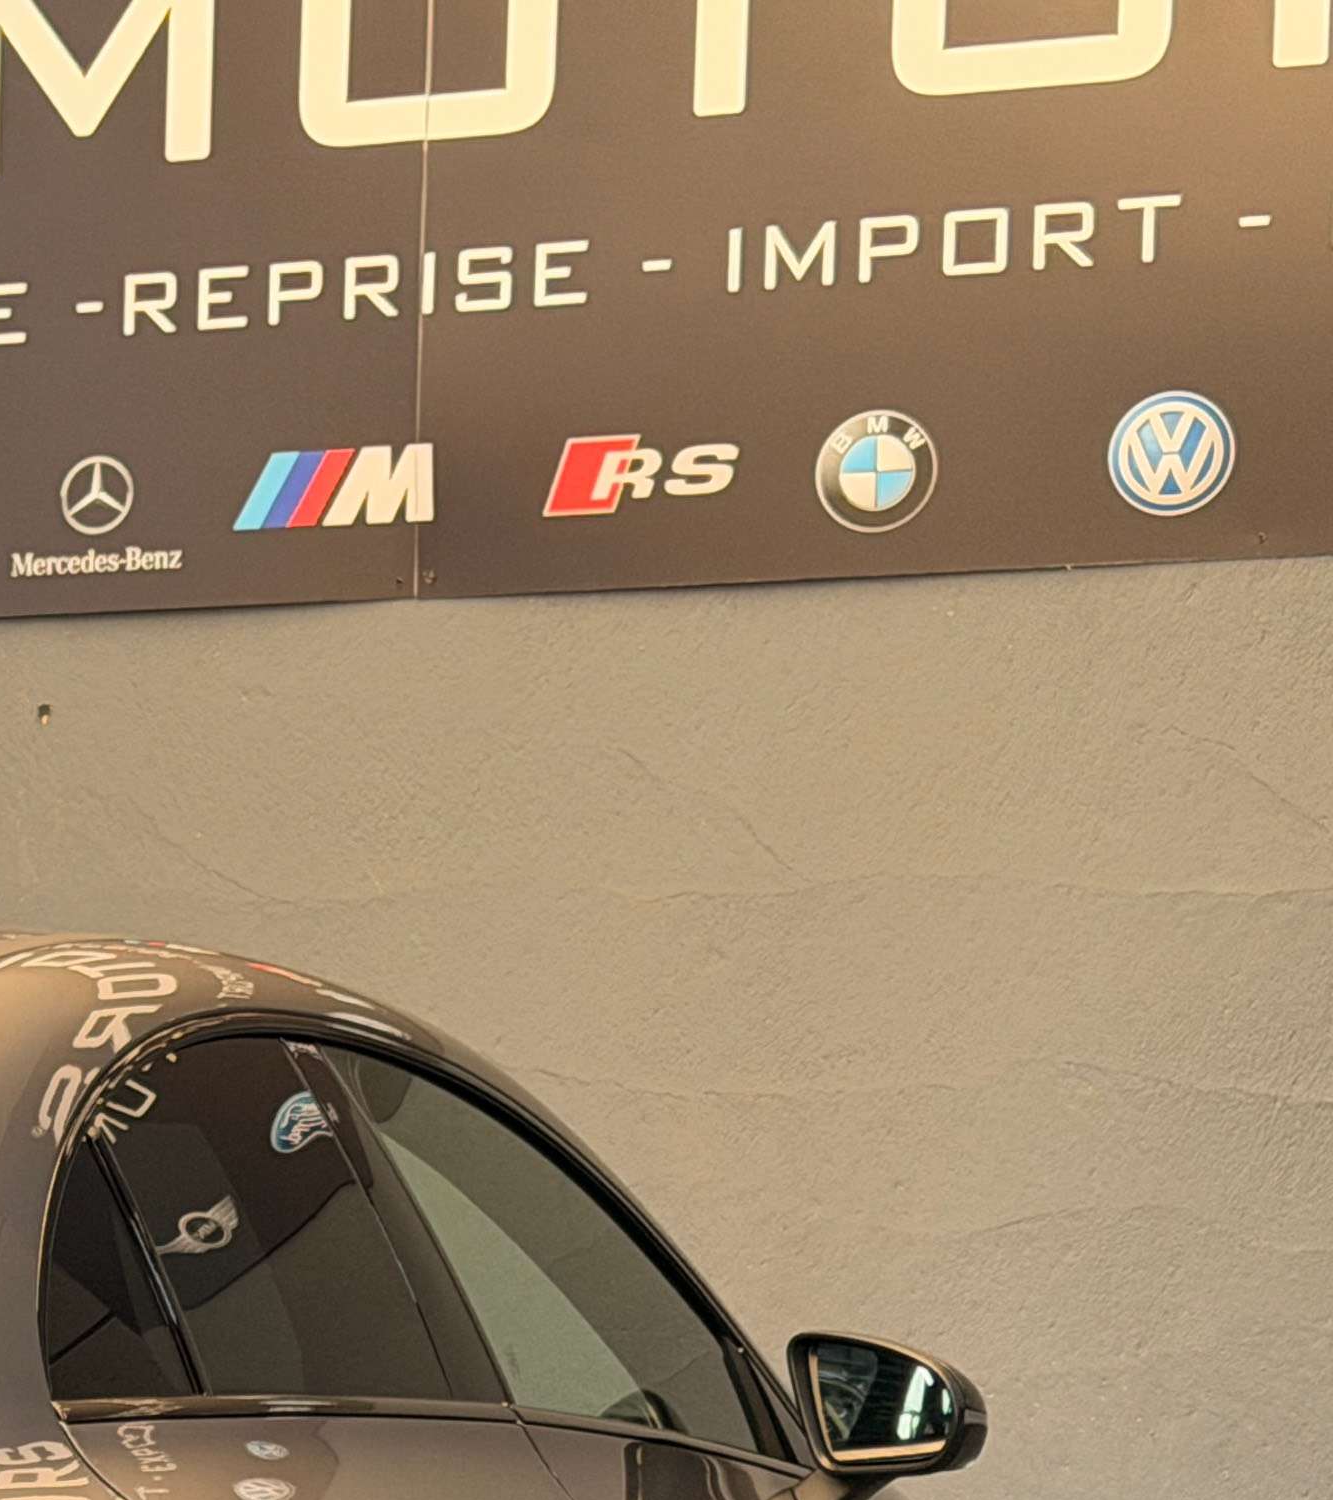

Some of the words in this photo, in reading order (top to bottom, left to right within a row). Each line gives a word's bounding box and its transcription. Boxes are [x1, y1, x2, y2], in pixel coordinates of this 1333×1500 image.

[727, 194, 1182, 293] IMPORT
[829, 415, 926, 454] BMW
[590, 442, 741, 501] RS
[10, 545, 183, 578] Mercedes-Benz
